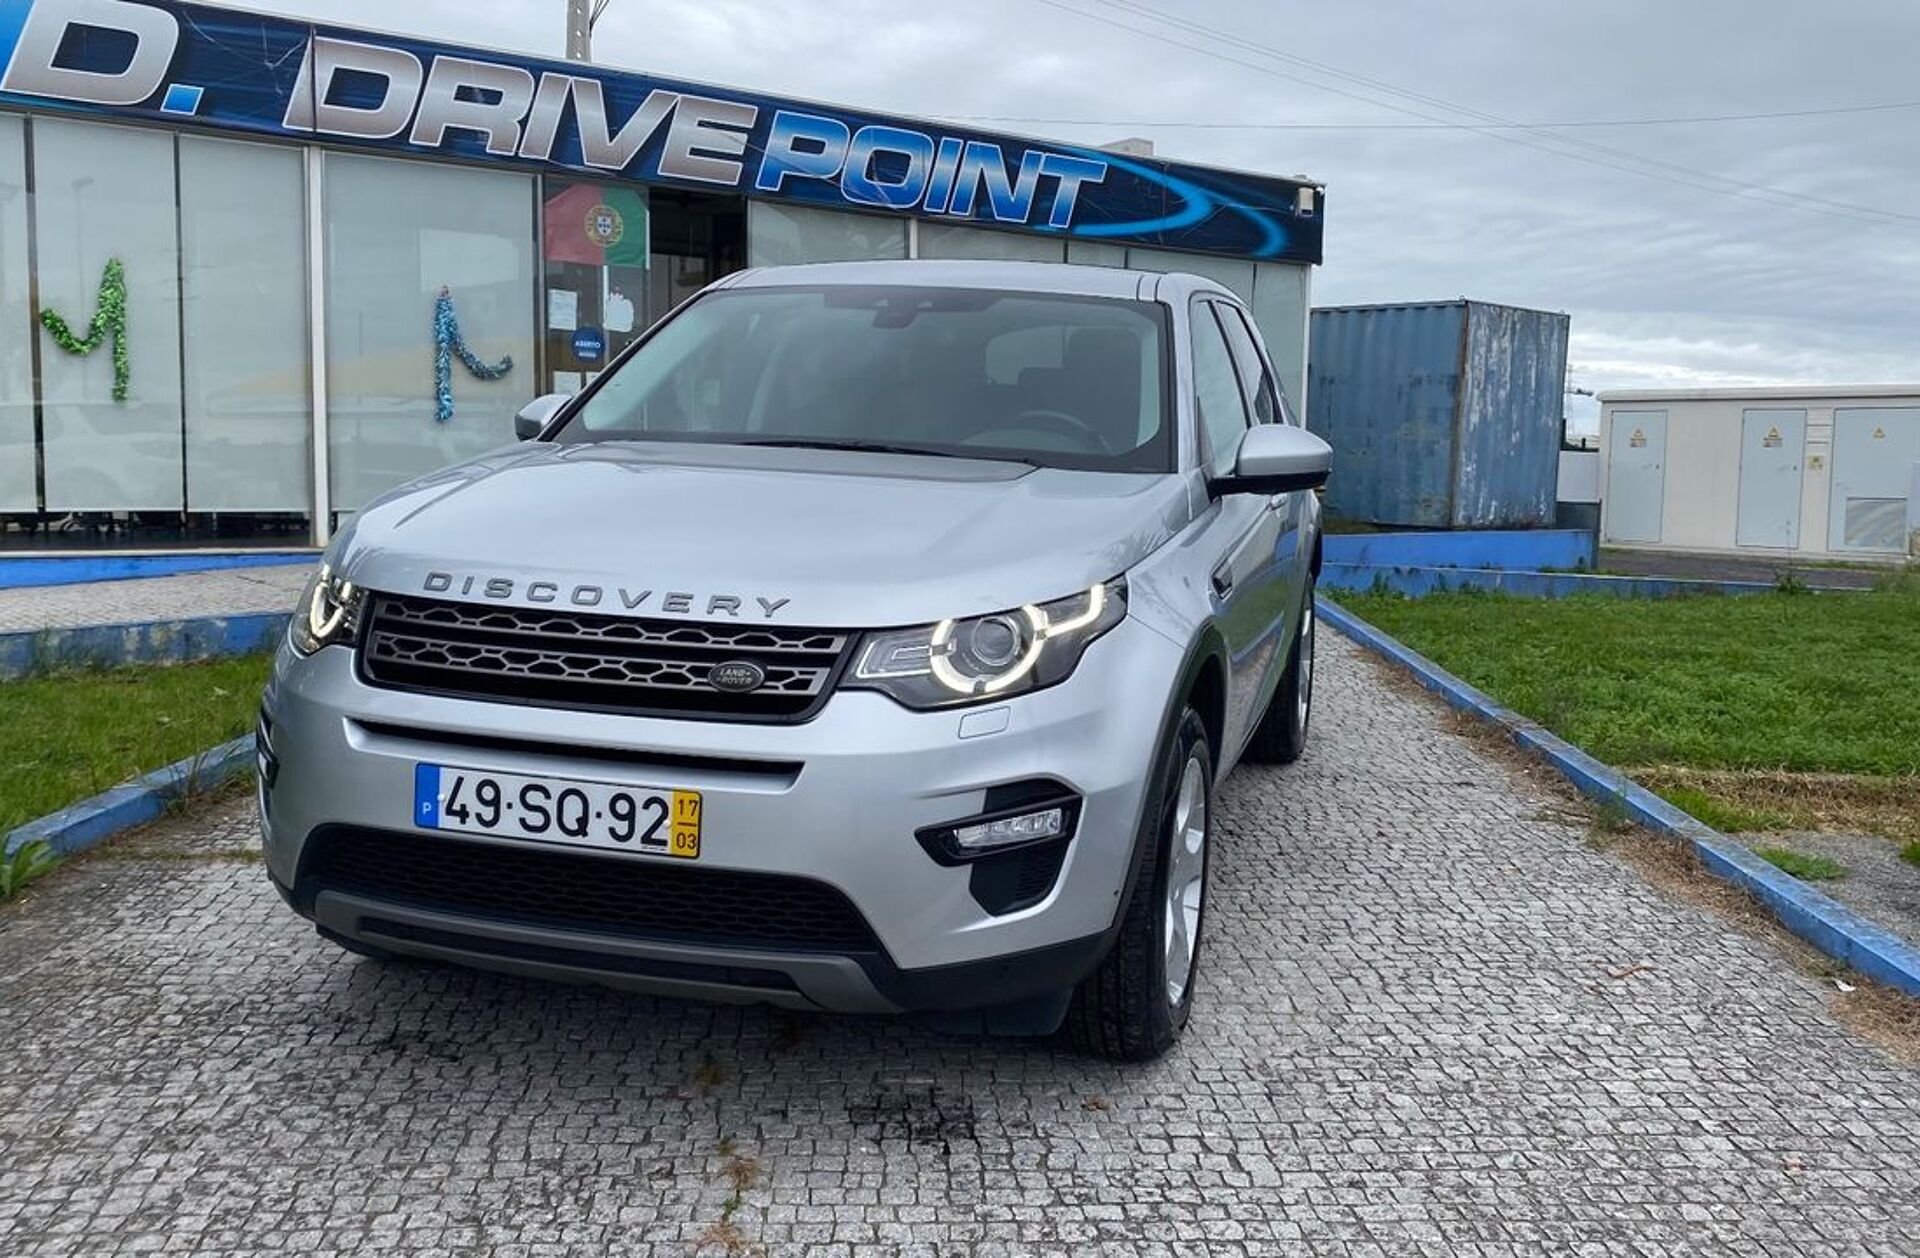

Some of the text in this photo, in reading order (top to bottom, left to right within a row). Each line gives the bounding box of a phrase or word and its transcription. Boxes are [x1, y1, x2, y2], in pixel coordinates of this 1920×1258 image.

[424, 572, 791, 617] DISCOVERY
[422, 802, 432, 815] P
[677, 799, 699, 817] 17
[676, 832, 697, 850] 03
